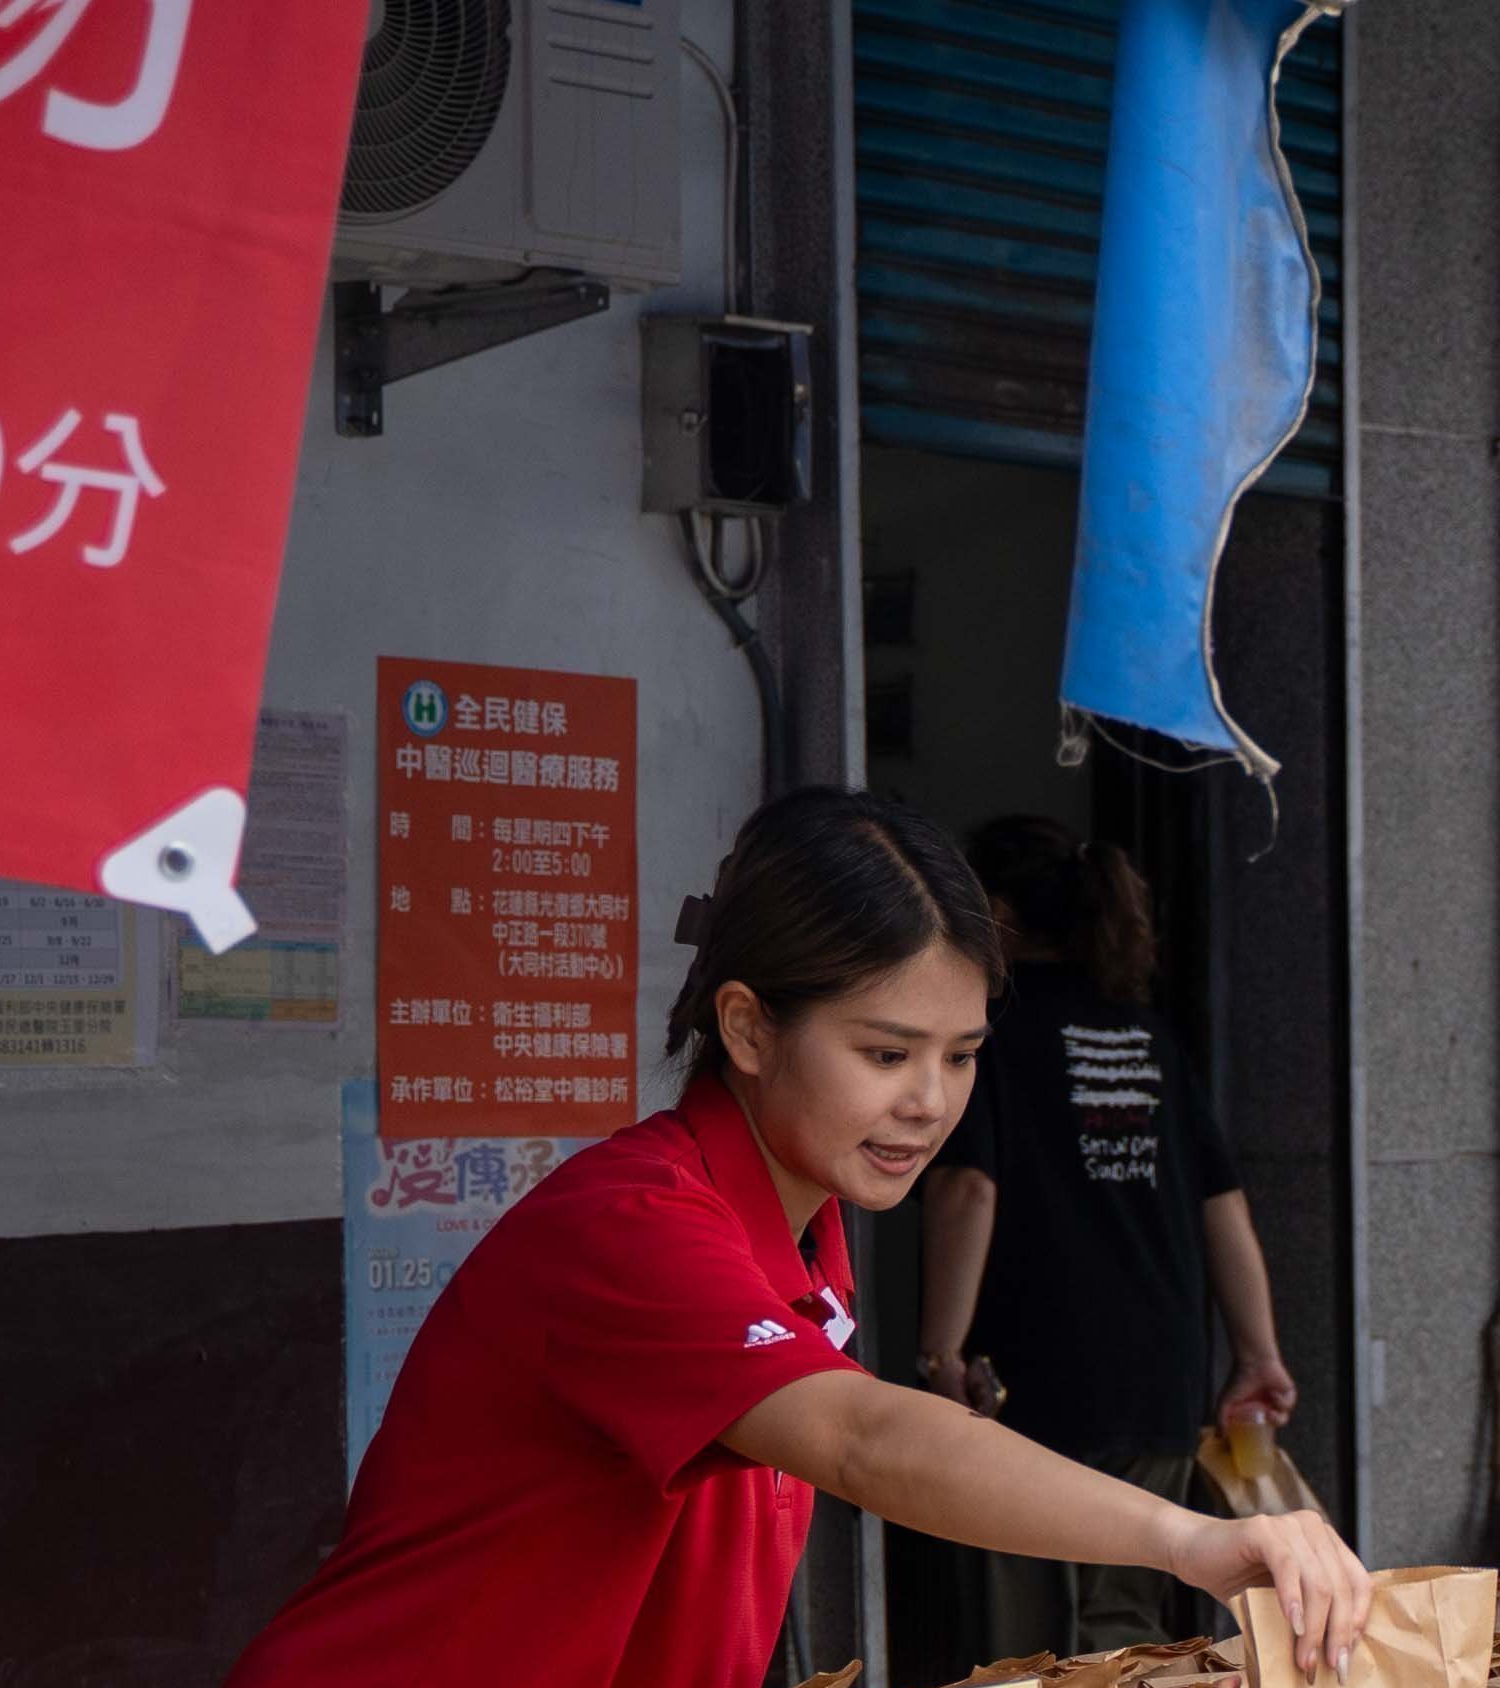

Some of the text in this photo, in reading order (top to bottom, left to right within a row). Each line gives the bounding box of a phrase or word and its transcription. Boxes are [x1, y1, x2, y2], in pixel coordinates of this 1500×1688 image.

[454, 693, 568, 737] 全民健保
[395, 742, 621, 793] 中醫巡迴醫療服務
[492, 849, 592, 878] 2:00至5:00
[493, 1032, 629, 1061] 中央健康保險署
